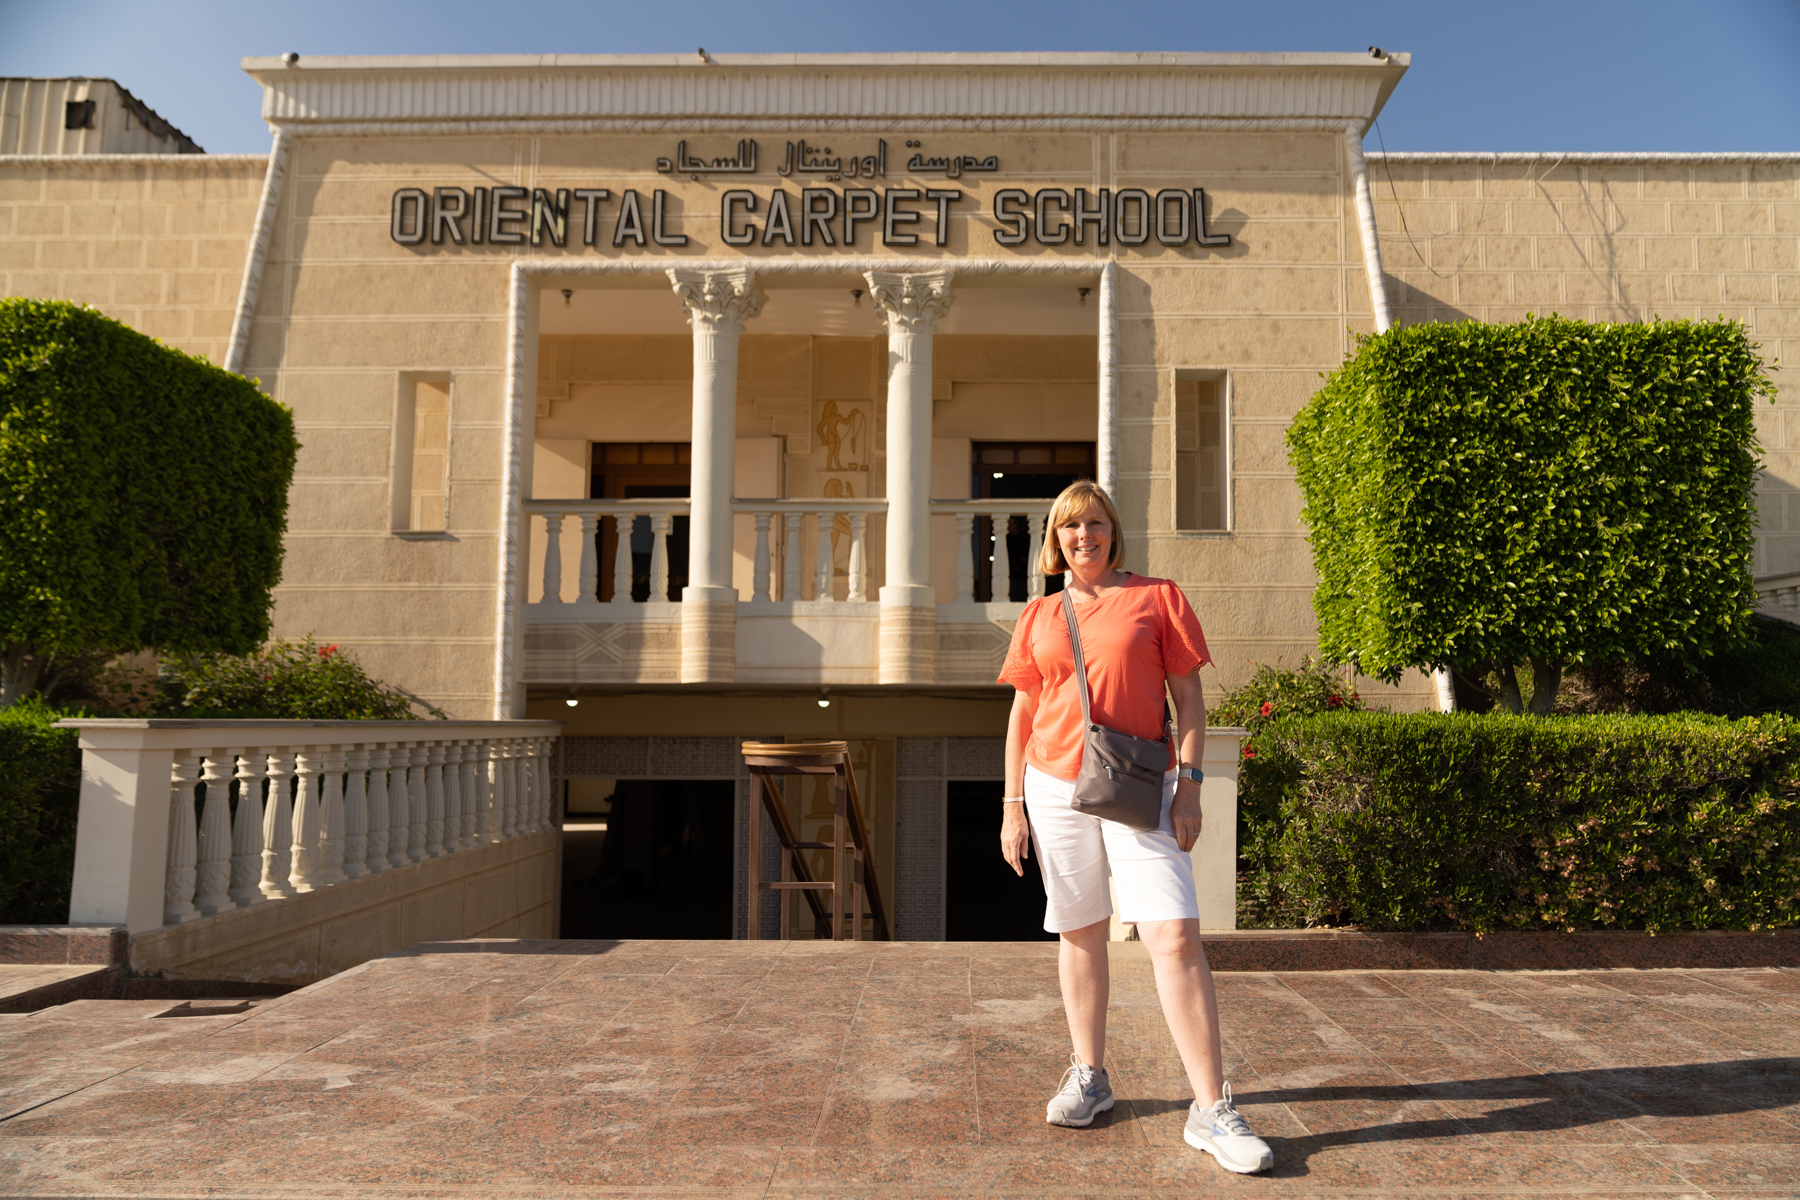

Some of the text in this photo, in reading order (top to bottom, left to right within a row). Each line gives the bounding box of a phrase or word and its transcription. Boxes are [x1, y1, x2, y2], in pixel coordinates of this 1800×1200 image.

[656, 138, 757, 181] للسجاد
[907, 139, 998, 178] مدرسة
[390, 186, 1231, 248] ORIENTAL CARPET SCHOOL
